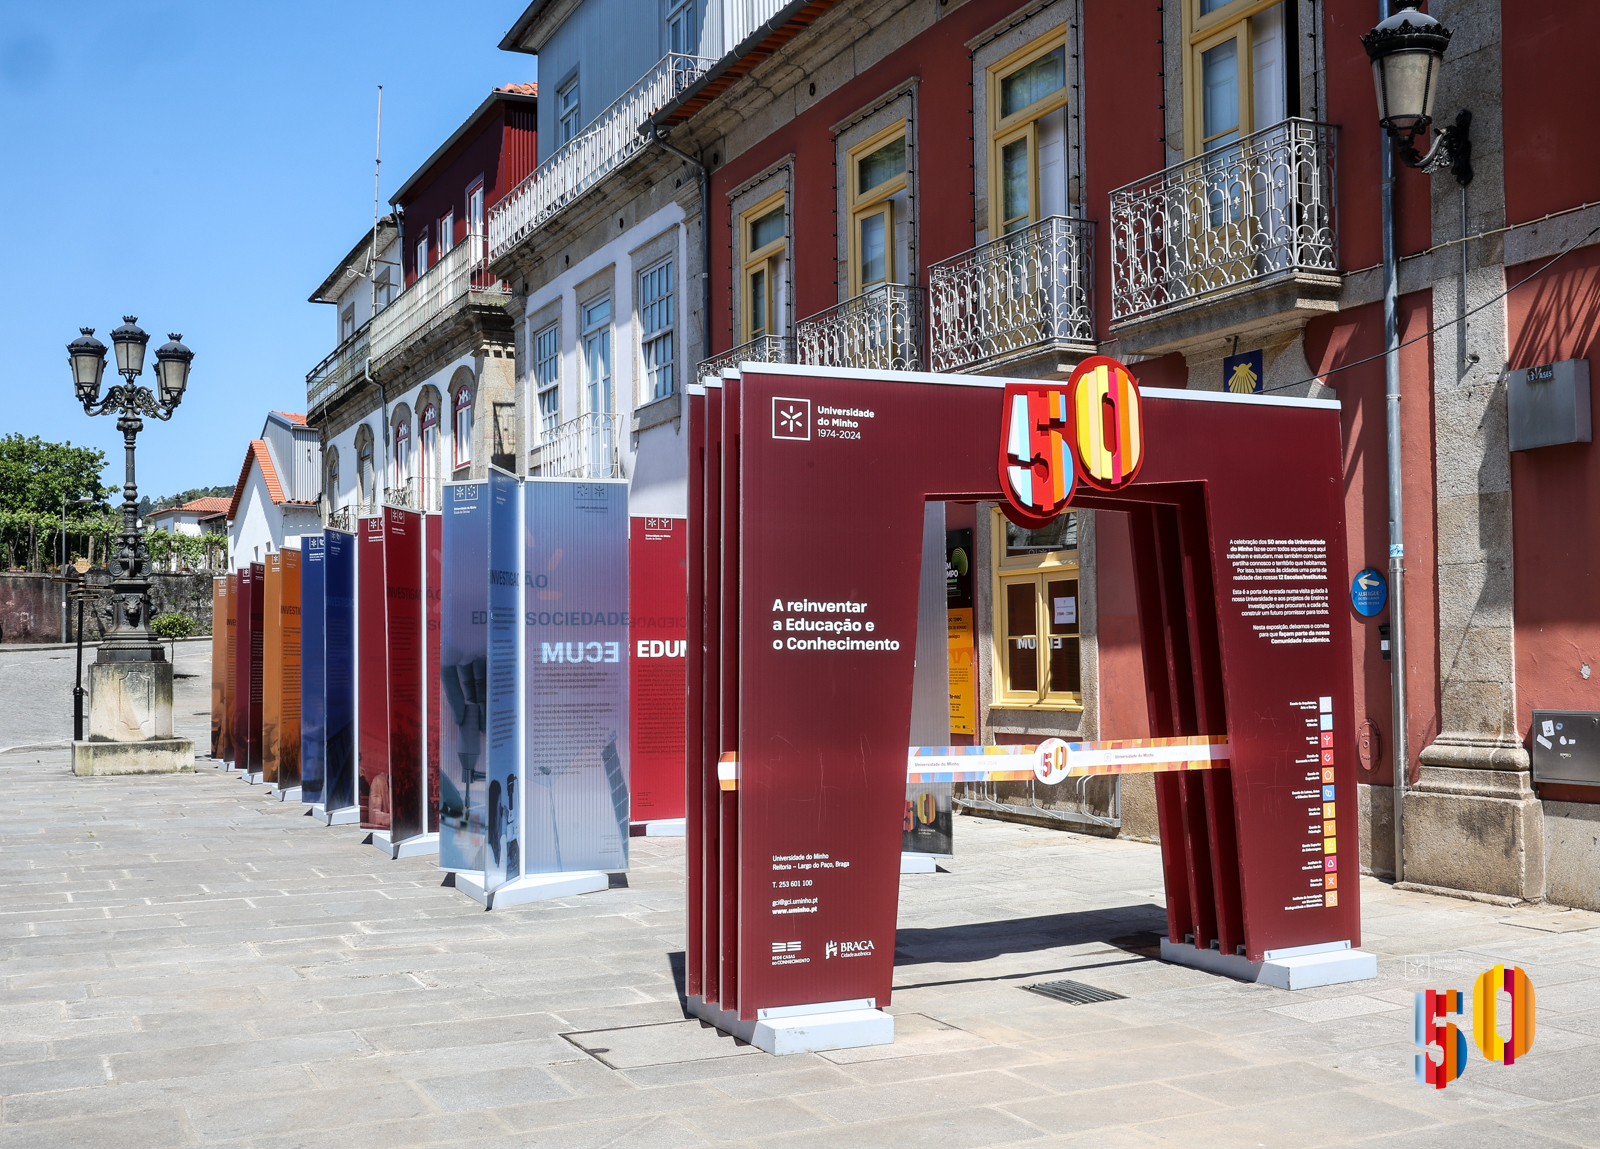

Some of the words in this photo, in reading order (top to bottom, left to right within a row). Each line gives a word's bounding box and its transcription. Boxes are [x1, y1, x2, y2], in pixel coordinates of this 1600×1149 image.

[818, 406, 874, 418] Universidade
[818, 417, 830, 426] do
[832, 418, 858, 428] Minho
[818, 428, 860, 440] 1974-2024
[1007, 365, 1141, 511] 50
[772, 598, 784, 612] A
[787, 598, 868, 613] reinventar
[525, 612, 629, 626] SOCIEDADE
[772, 620, 782, 631] a
[786, 618, 862, 634] Educação
[865, 621, 875, 632] e
[772, 639, 783, 650] o
[786, 637, 900, 650] Conhecimento
[1041, 746, 1067, 778] 50
[772, 897, 818, 907] gci@gci.uminho.pt
[772, 906, 818, 914] www.uminho.pt
[840, 940, 875, 952] BRAGA
